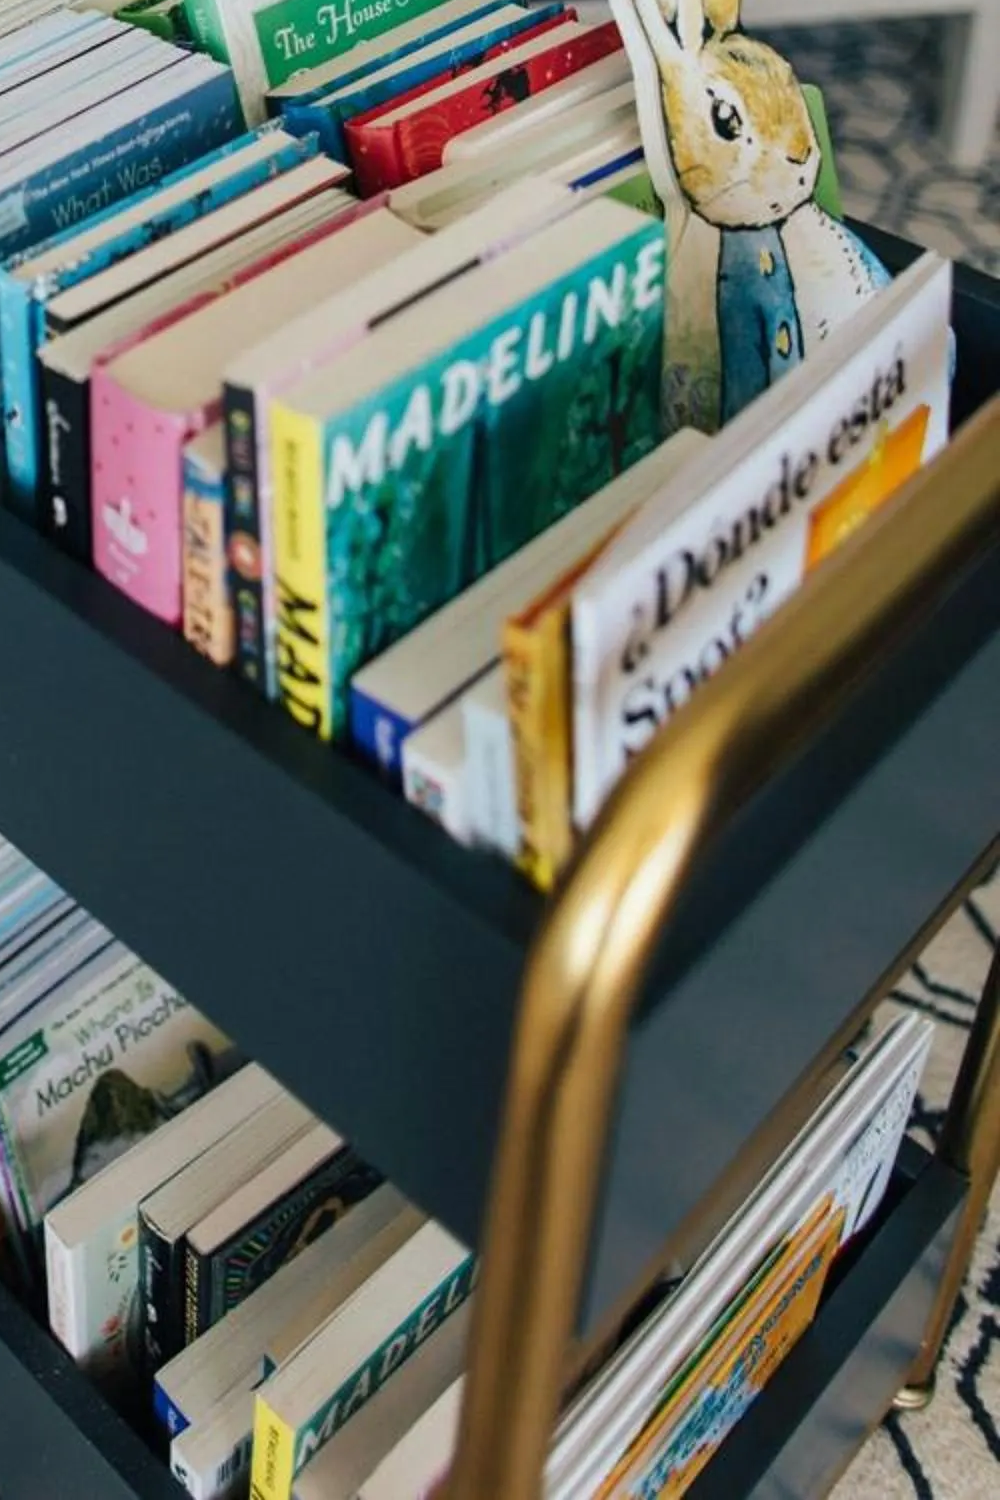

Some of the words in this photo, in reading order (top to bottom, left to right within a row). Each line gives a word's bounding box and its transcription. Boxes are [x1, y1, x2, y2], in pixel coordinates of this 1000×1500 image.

[275, 23, 316, 61] The
[51, 177, 114, 229] What
[328, 238, 664, 508] MADELINE
[72, 998, 134, 1046] Where
[35, 1043, 115, 1117] Machu
